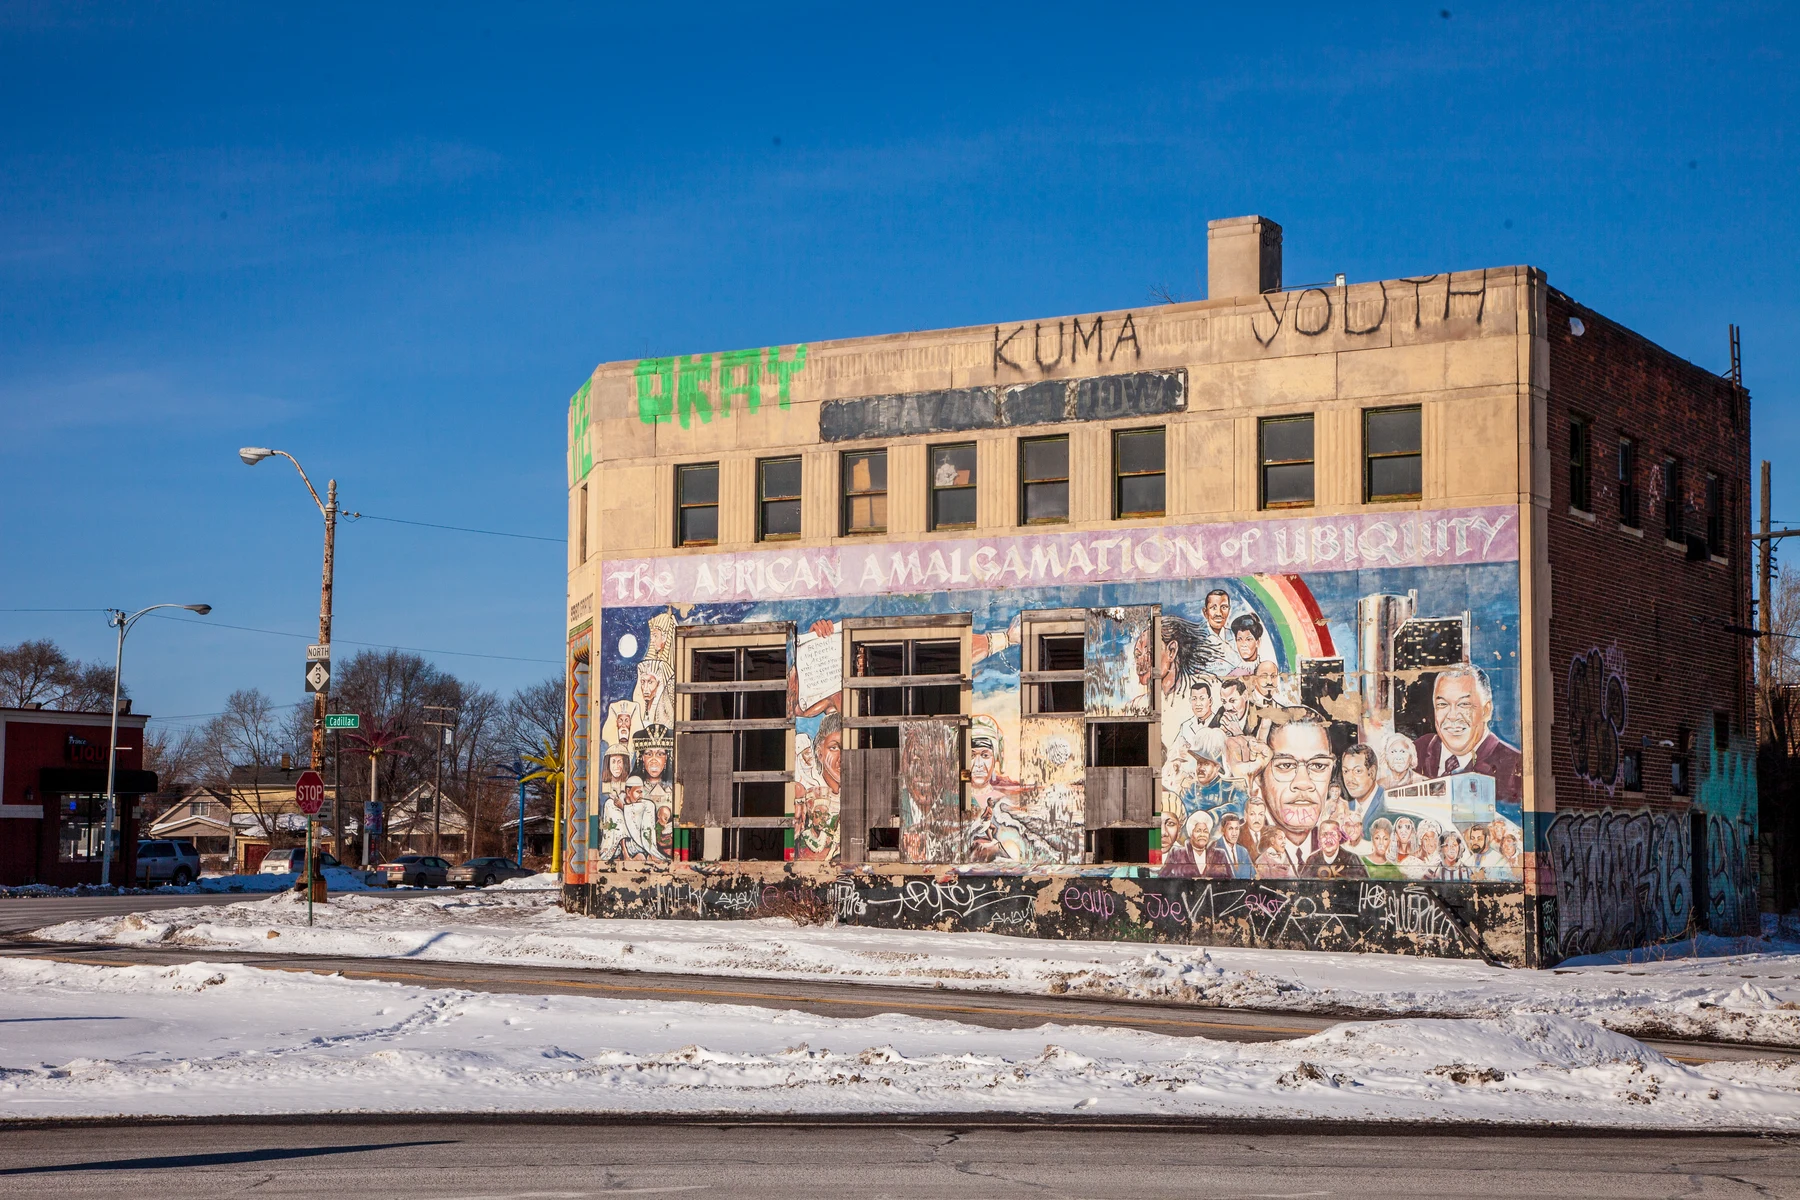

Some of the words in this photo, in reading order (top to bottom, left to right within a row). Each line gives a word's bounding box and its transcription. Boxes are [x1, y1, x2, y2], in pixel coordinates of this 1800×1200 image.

[1251, 268, 1487, 349] YOUTH
[993, 312, 1142, 377] KUMA
[606, 563, 677, 600] The
[692, 555, 844, 600] AFRICAN
[859, 535, 1209, 588] AMALGAMATION
[1220, 527, 1263, 567] of
[1274, 514, 1513, 566] UBIQUITY
[308, 648, 329, 657] NORTH
[315, 673, 321, 684] 3
[329, 716, 355, 726] Cadillac
[298, 785, 323, 801] STOP
[1317, 865, 1345, 880] OK
